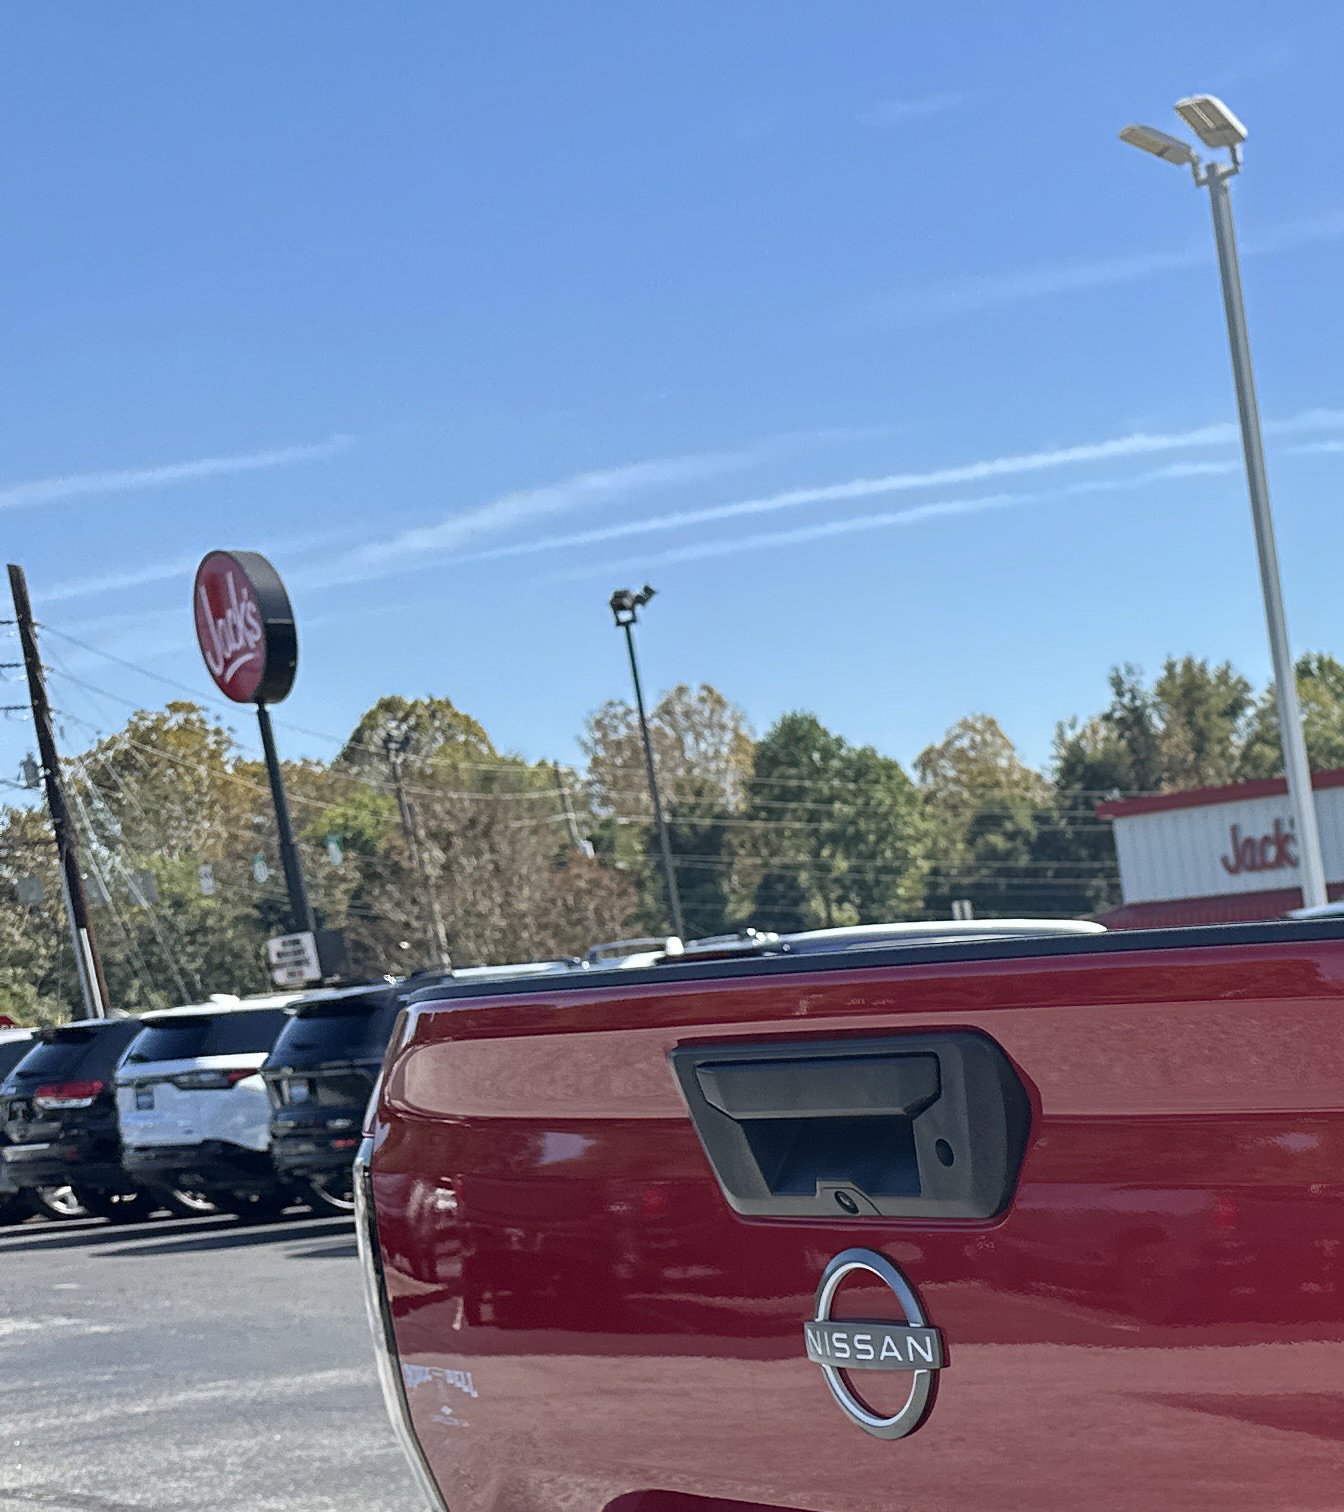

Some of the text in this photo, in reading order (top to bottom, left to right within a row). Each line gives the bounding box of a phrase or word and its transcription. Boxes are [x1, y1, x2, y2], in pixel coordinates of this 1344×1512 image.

[200, 571, 262, 677] Jack's
[1221, 817, 1299, 875] Jack'
[806, 1328, 935, 1364] NISSAN
